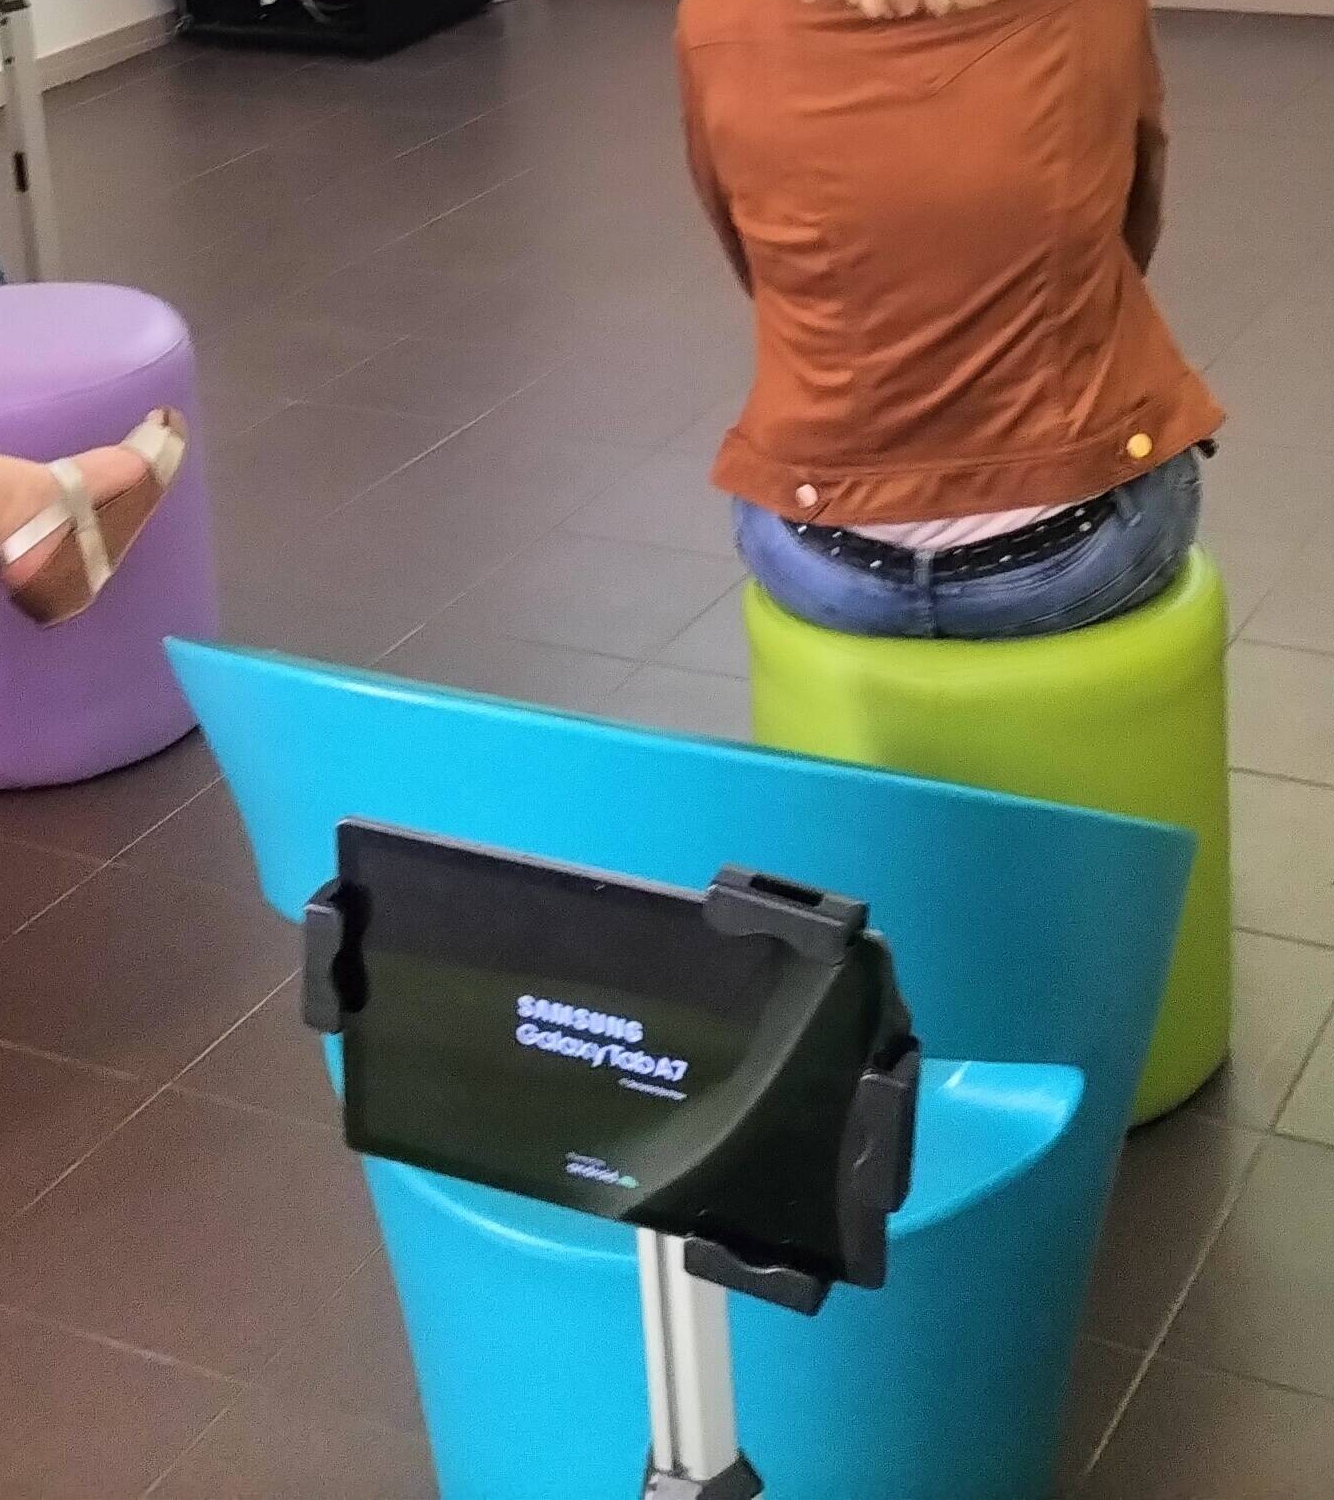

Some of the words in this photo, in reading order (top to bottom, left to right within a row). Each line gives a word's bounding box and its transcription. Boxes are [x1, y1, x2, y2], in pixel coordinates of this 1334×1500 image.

[517, 994, 643, 1043] SAMSUNG
[516, 1023, 606, 1067] Galaxy
[606, 1044, 656, 1075] Tab
[653, 1056, 689, 1081] A7
